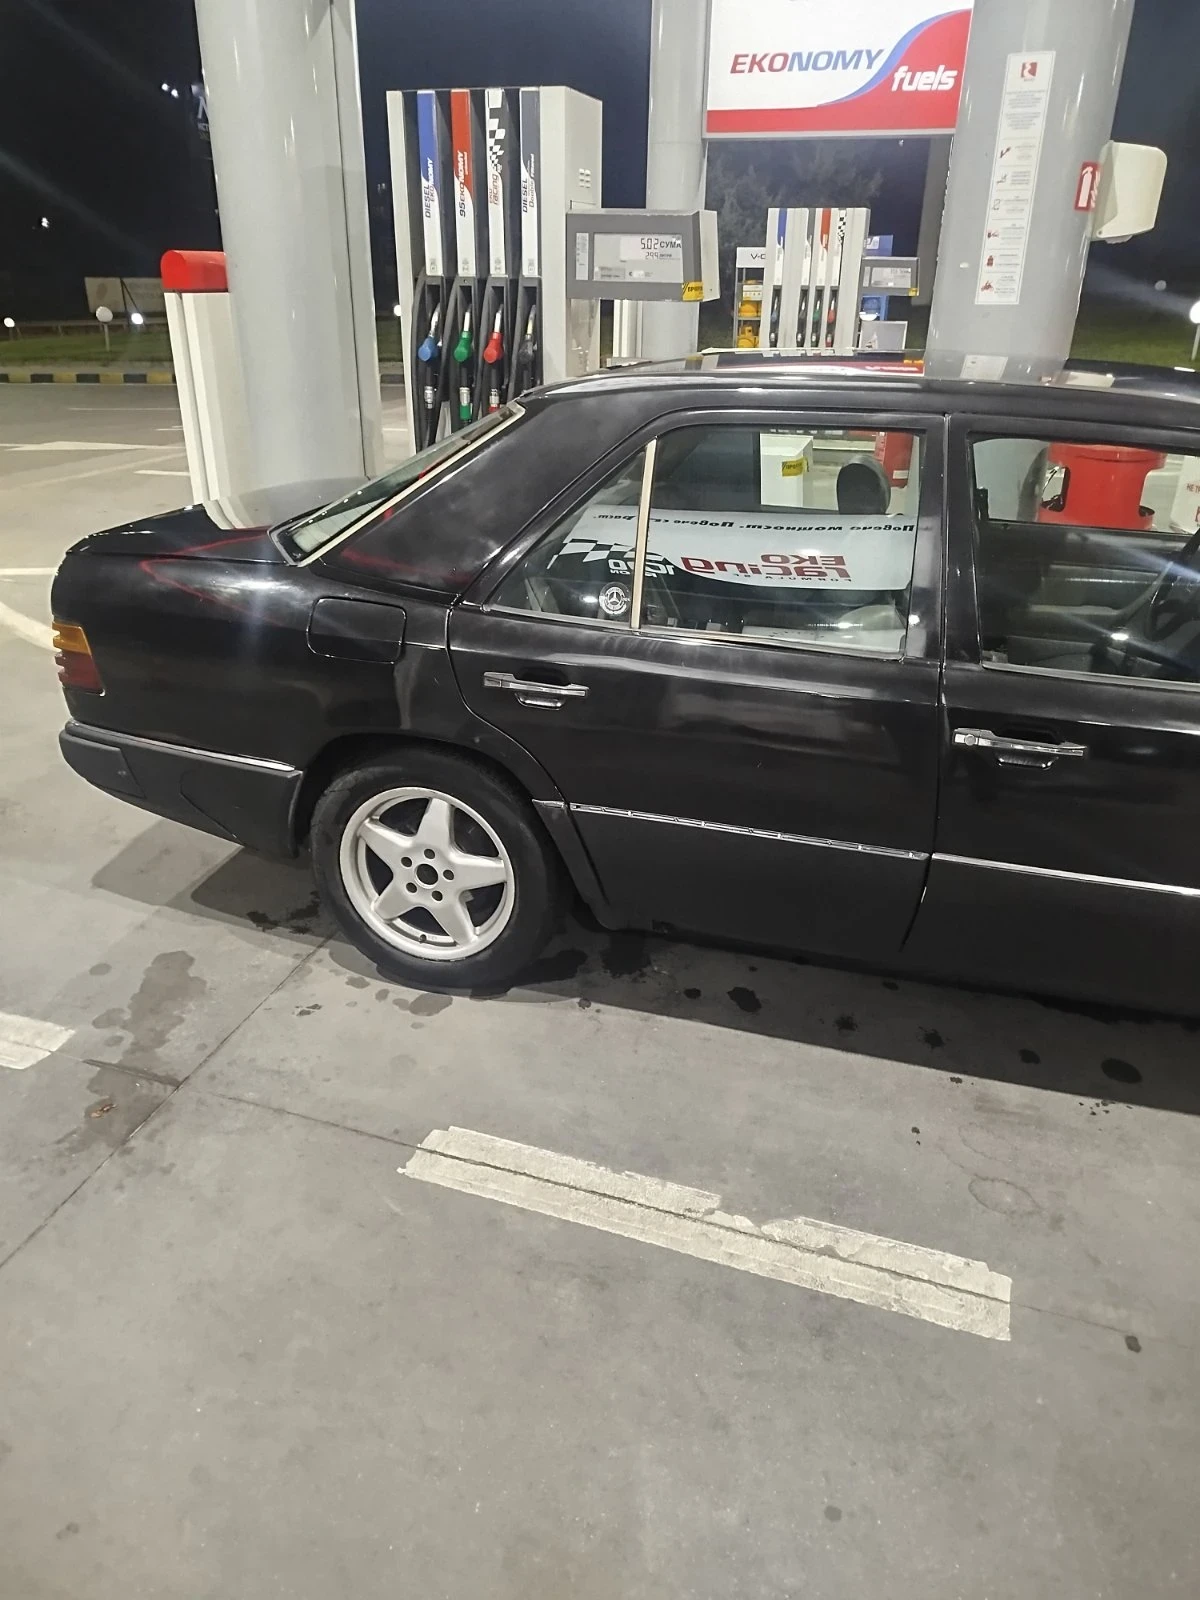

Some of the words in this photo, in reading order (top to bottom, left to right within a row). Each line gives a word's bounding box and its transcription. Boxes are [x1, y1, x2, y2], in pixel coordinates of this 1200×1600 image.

[730, 49, 885, 74] EKONOMY
[891, 65, 957, 92] fuels
[427, 156, 435, 202] EKONOMY
[424, 184, 432, 219] DIESEL
[659, 240, 682, 249] СУМА
